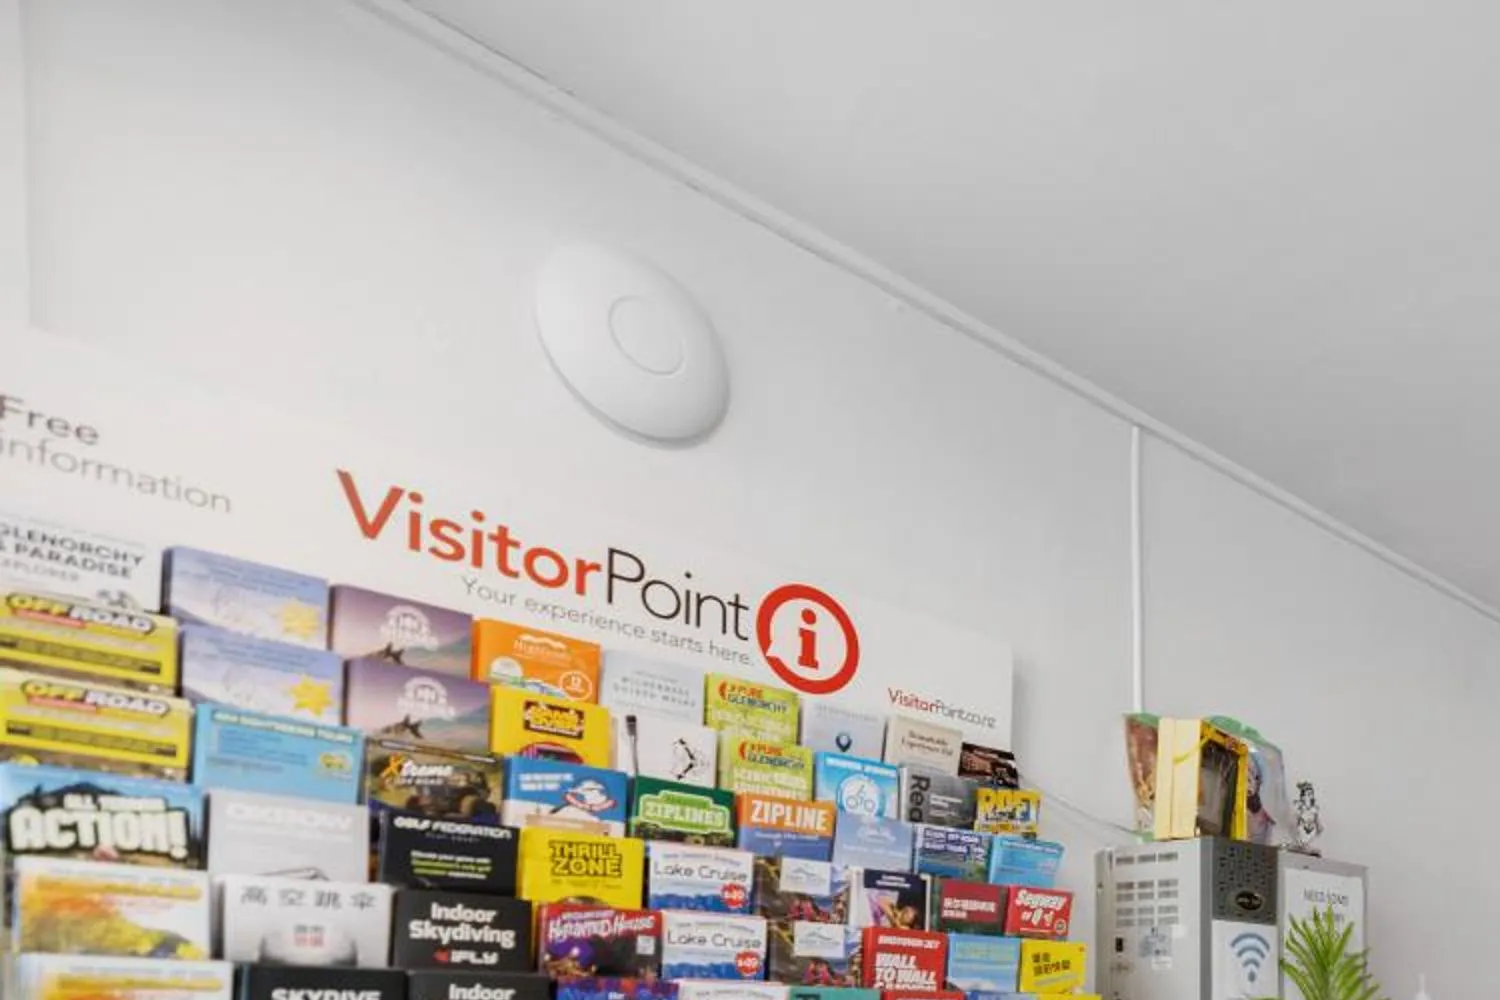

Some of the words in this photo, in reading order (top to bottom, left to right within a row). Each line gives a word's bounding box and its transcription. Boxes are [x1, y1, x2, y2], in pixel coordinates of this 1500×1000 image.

[0, 394, 99, 446] Free
[0, 436, 232, 515] information
[14, 540, 132, 581] PARADISE
[336, 468, 750, 642] VisitorPoint
[461, 574, 517, 607] Your
[524, 595, 647, 640] experience
[650, 624, 704, 655] starts
[751, 799, 829, 831] ZIPLINE
[10, 806, 189, 861] ACTION!
[548, 839, 619, 860] THRILL
[551, 857, 624, 878] ZONE
[653, 860, 694, 879] Lake
[698, 865, 749, 883] Cruise
[430, 902, 497, 924] Indoor
[409, 920, 516, 948] Skydiving
[667, 930, 707, 947] Lake
[711, 933, 762, 950] Cruise
[875, 952, 917, 969] WALL
[876, 967, 899, 983] TO
[897, 968, 937, 985] WALL
